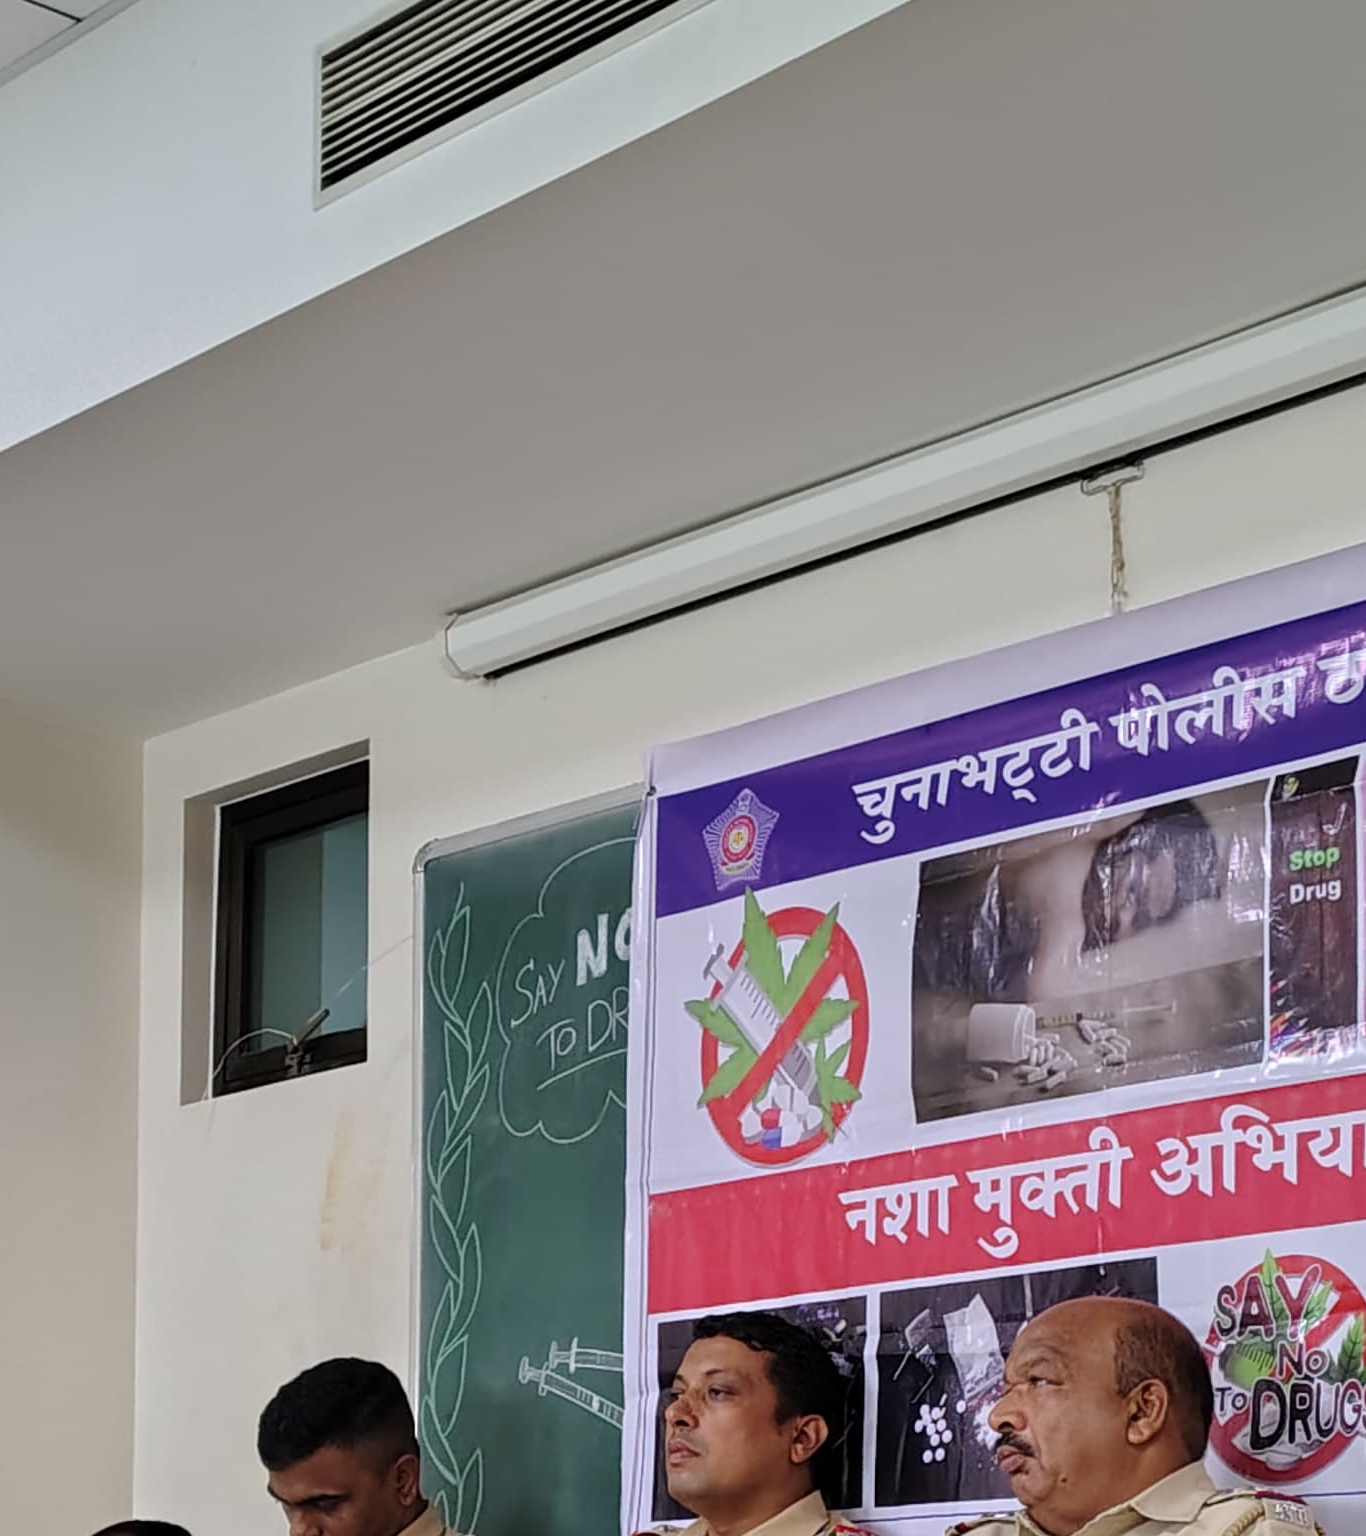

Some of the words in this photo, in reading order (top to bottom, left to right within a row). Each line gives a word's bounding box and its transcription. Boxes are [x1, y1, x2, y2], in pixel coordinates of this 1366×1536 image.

[1109, 666, 1308, 756] पोलीस
[1289, 846, 1340, 872] Stop
[1289, 879, 1342, 905] Drug
[511, 957, 566, 1029] SAY
[536, 1018, 577, 1071] TO
[838, 1174, 959, 1247] नशा
[966, 1125, 1134, 1260] मुक्ती
[1215, 1264, 1322, 1341] SAY
